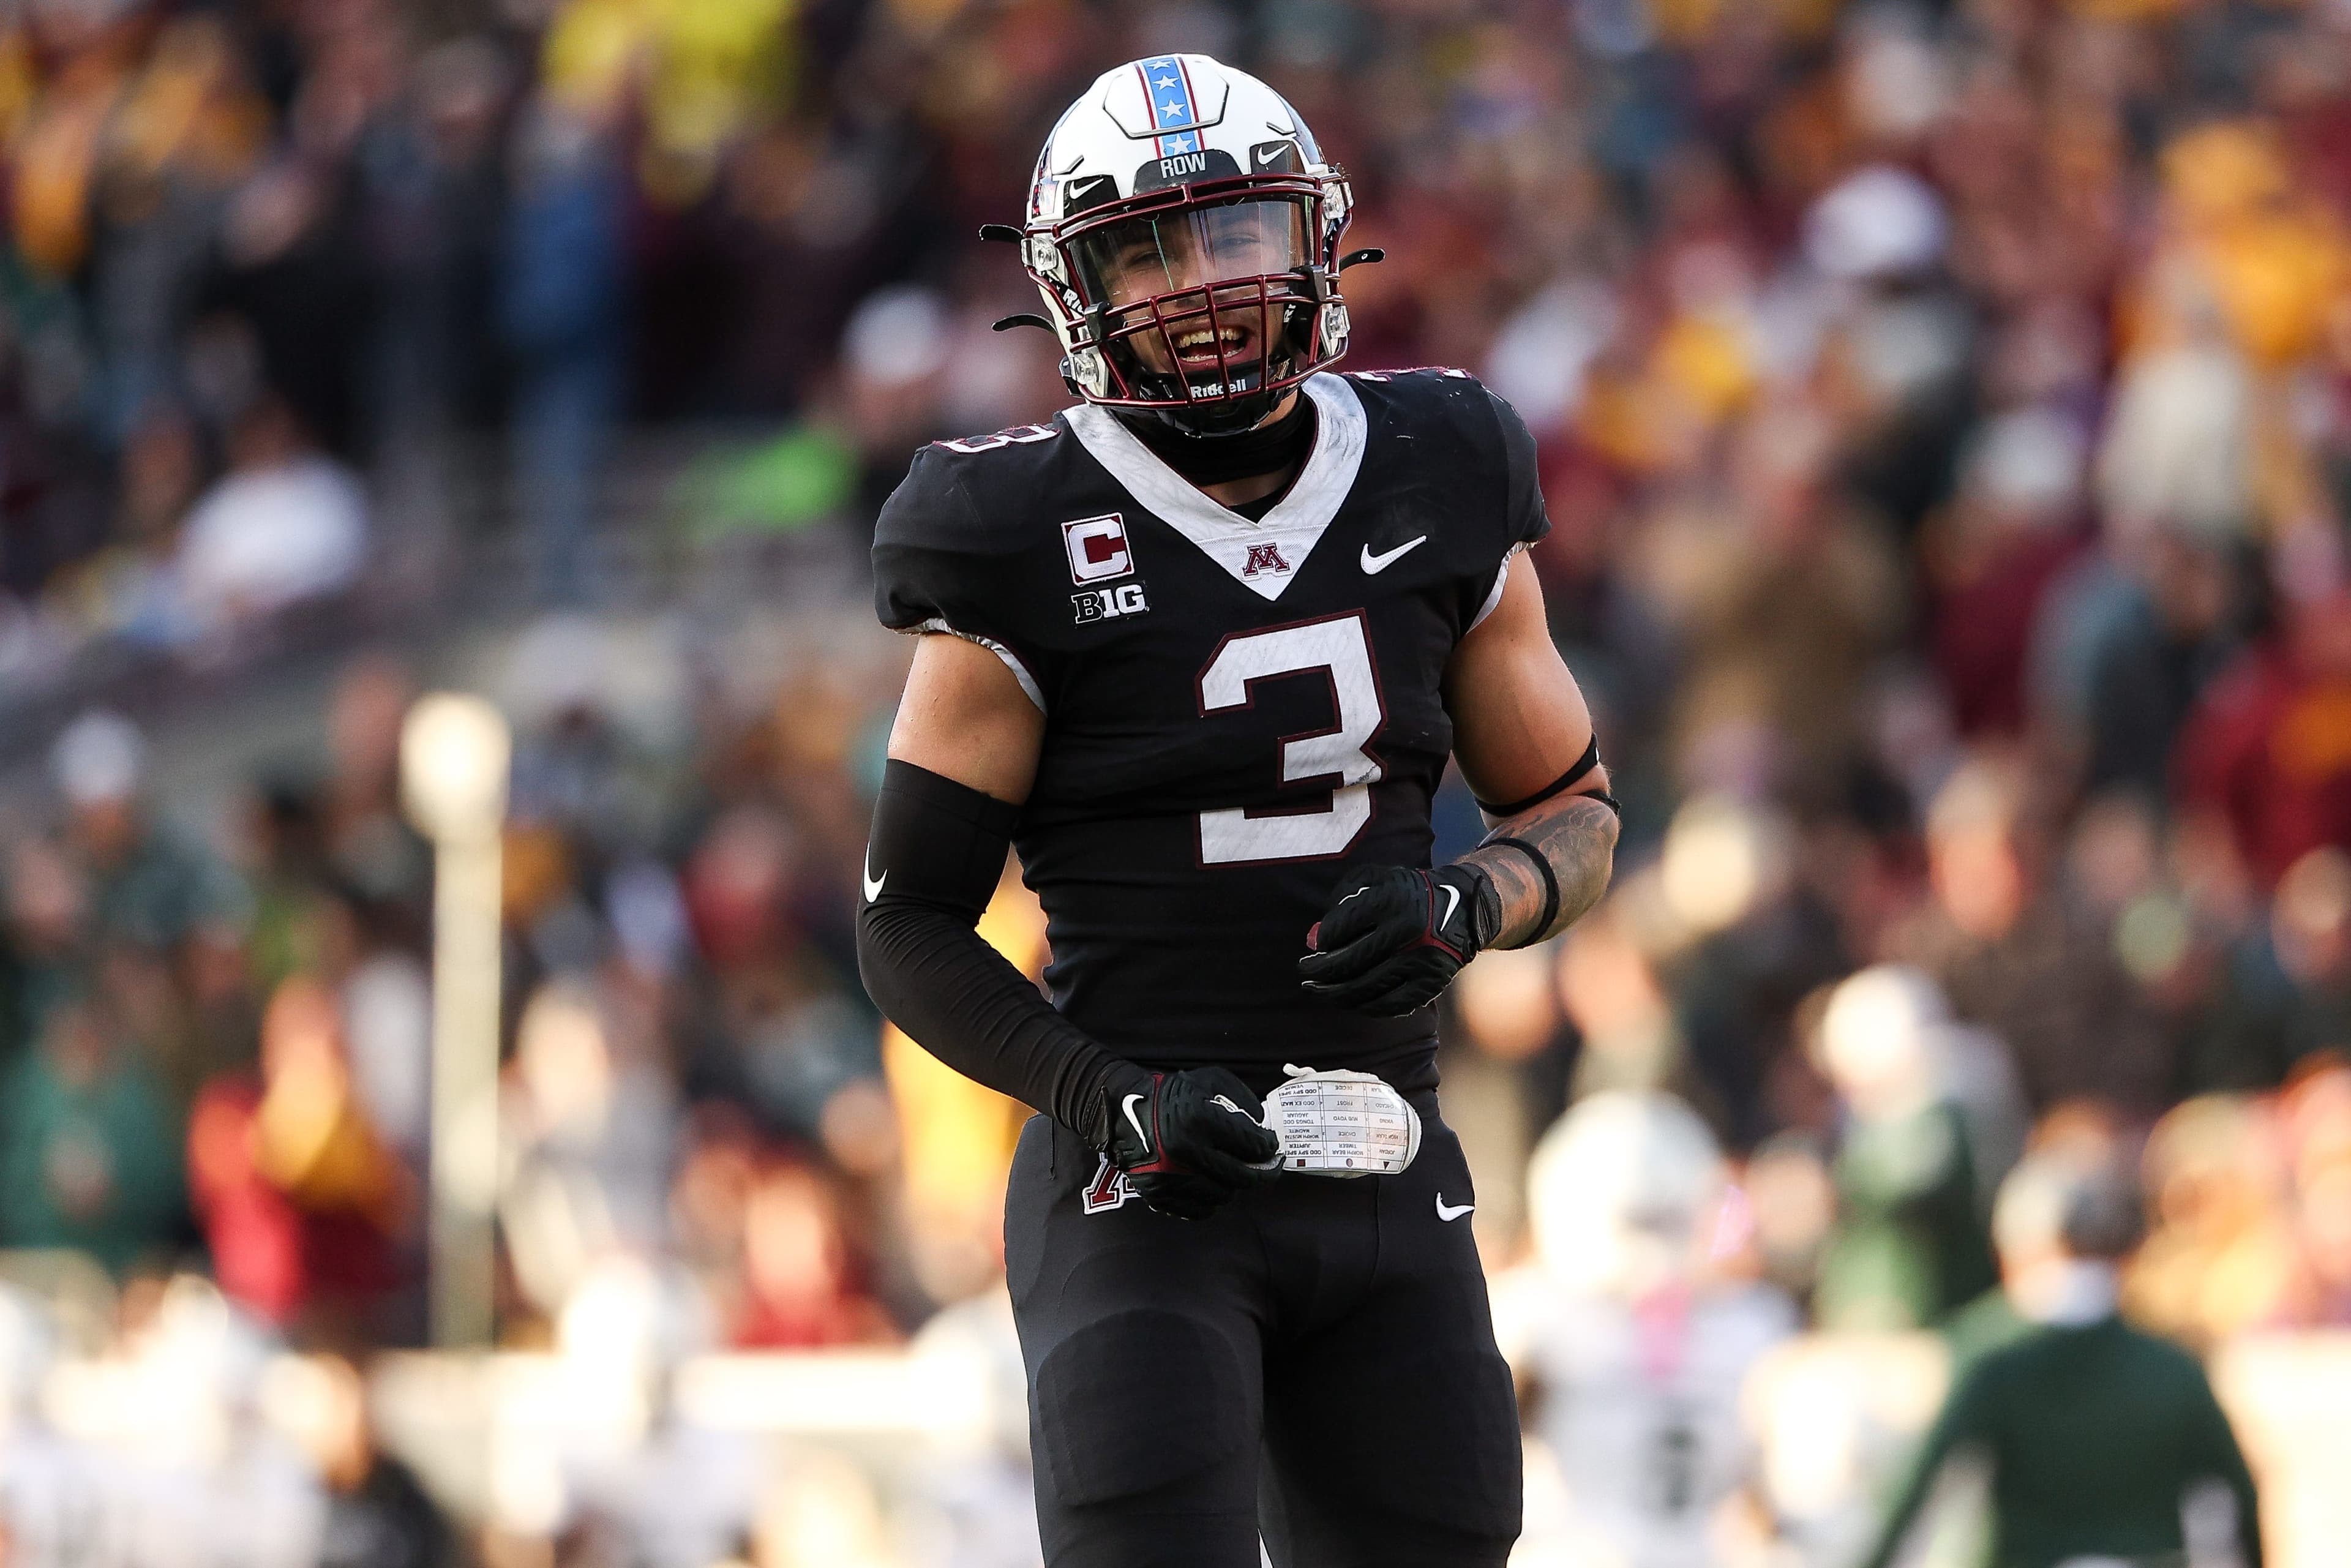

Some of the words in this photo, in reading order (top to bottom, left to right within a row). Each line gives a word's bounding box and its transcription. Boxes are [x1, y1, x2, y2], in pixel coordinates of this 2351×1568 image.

[1160, 152, 1205, 179] ROW
[1068, 518, 1128, 578] C
[1243, 542, 1291, 577] M
[1197, 609, 1386, 866] 3
